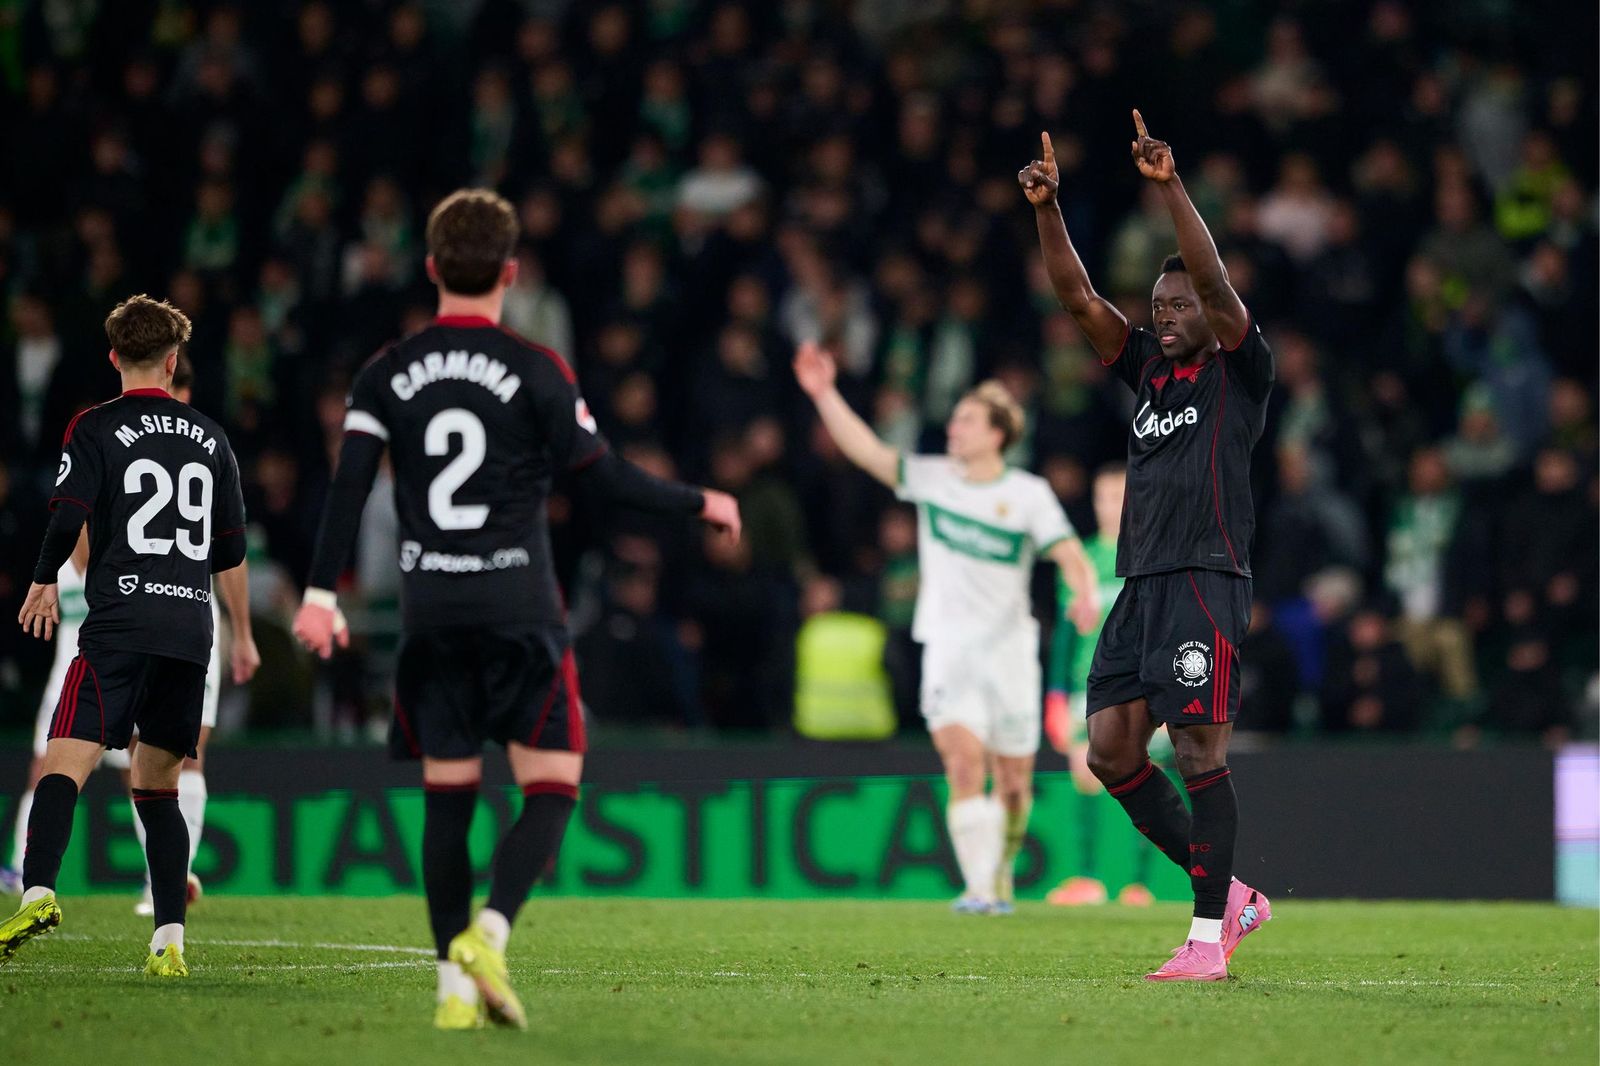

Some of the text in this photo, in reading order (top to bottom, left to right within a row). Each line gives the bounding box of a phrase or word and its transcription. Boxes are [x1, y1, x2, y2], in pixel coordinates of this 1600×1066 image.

[390, 350, 521, 404] CARMONA
[114, 414, 217, 455] M.SIERRA
[424, 407, 490, 530] 2
[124, 458, 213, 561] 29
[1178, 641, 1210, 652] JUICE TIME
[88, 778, 1047, 886] ETASTICA
